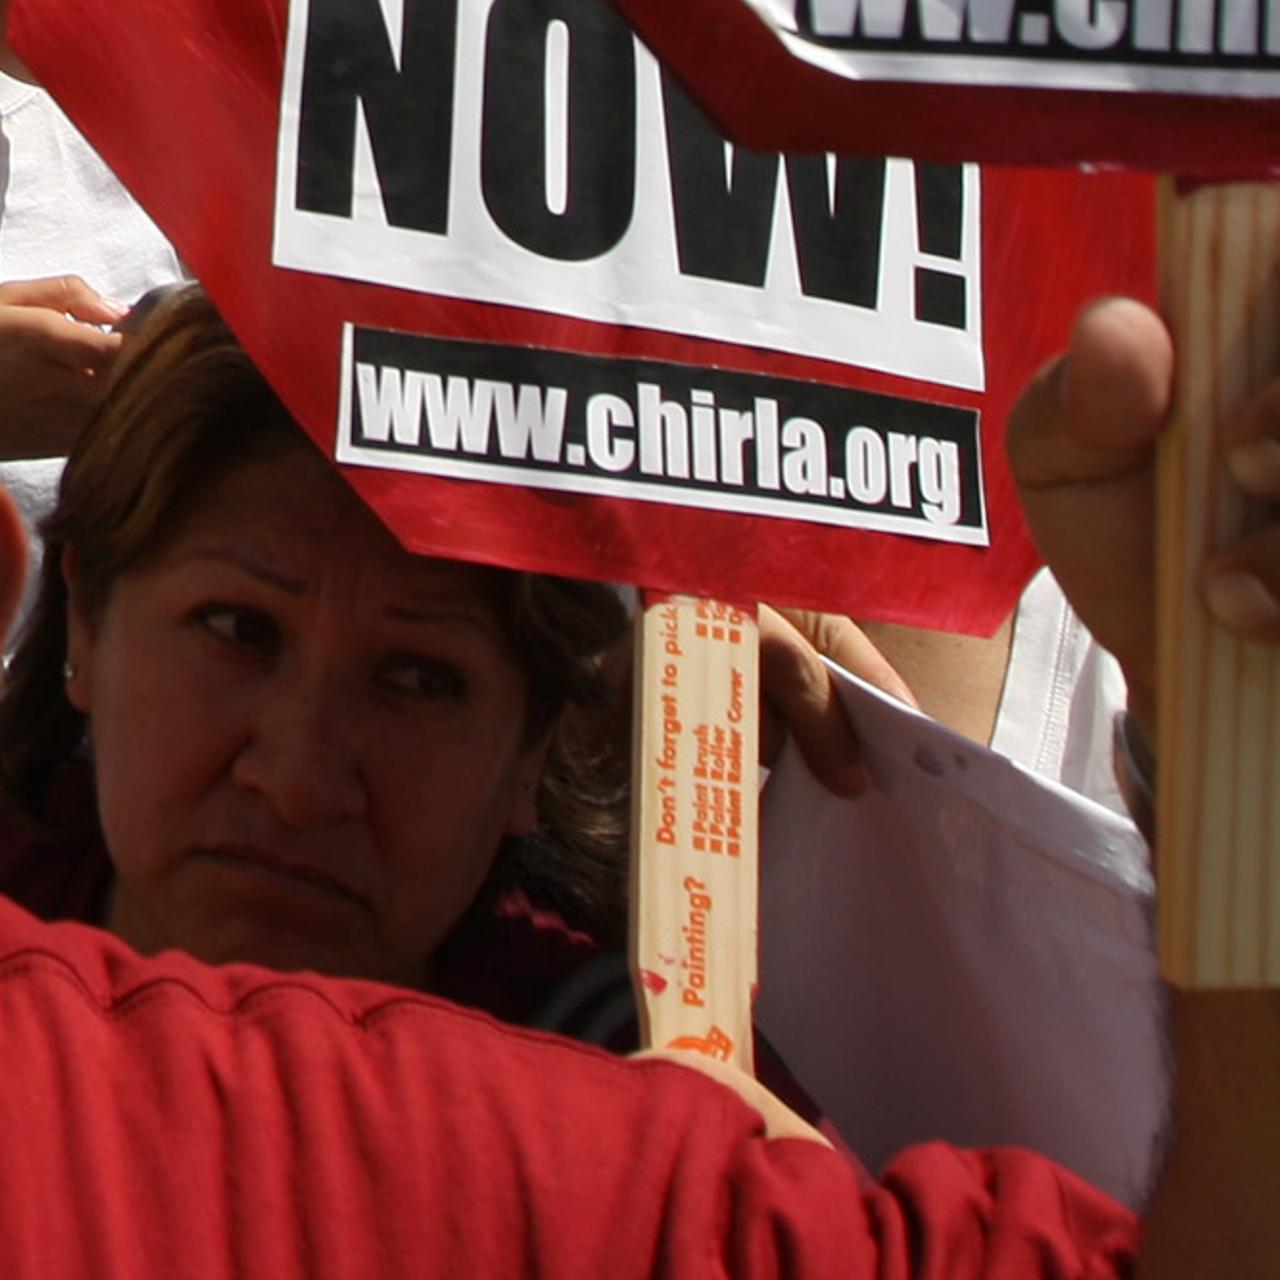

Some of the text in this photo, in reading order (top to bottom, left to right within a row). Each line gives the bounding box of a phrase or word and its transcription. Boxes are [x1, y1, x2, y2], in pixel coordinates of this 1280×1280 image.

[355, 362, 960, 527] www.chirla.org
[660, 663, 678, 688] to
[656, 695, 683, 770] forget
[692, 724, 709, 834] Paint Brush
[710, 725, 725, 837] Paint Roller
[726, 667, 743, 840] Paint Roller Cover
[655, 777, 677, 846] Don't
[680, 875, 713, 1008] Painting?
